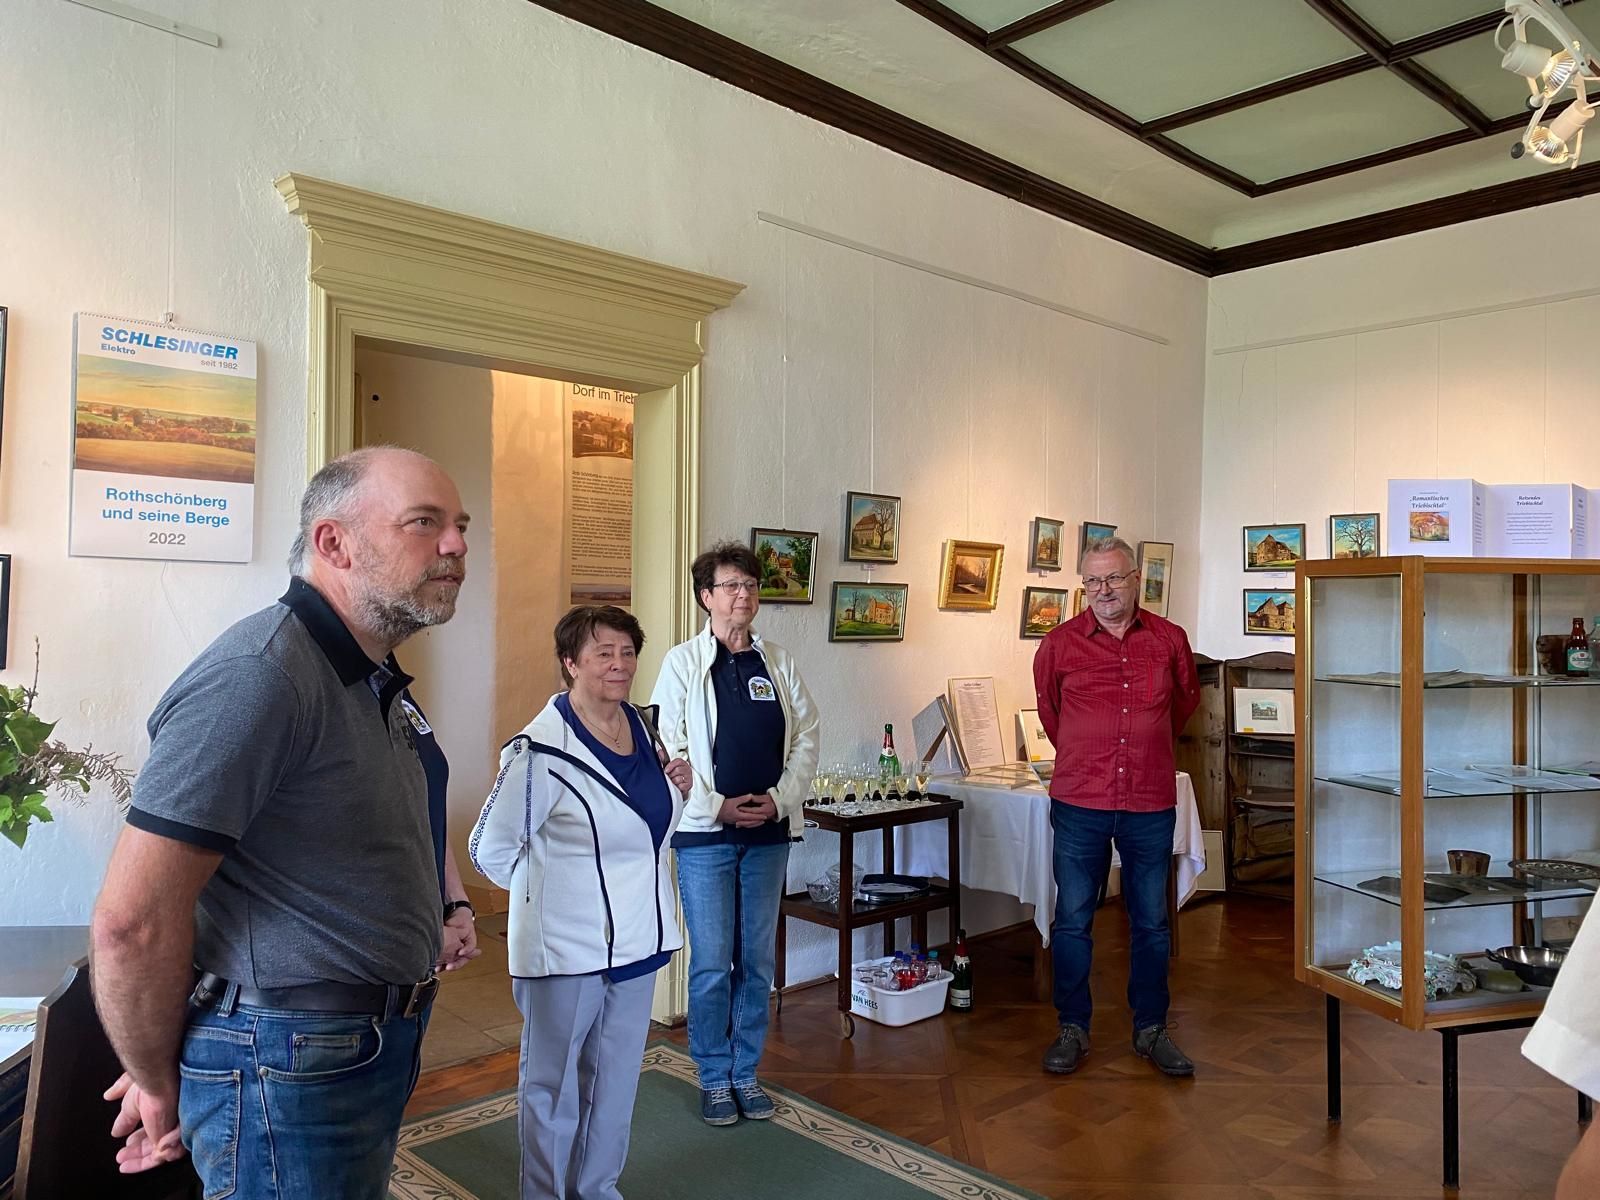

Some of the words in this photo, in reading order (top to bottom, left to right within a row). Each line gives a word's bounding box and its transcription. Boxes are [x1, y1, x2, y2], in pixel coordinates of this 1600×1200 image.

[101, 326, 239, 360] SCHLESINGER
[101, 343, 136, 355] Elektro
[200, 359, 216, 368] seit
[573, 383, 596, 398] Dorf
[598, 388, 611, 401] im
[106, 487, 227, 511] Rothschönberg
[102, 508, 134, 520] und
[138, 510, 181, 523] seine
[185, 511, 230, 528] Berge
[149, 532, 187, 545] 2022
[865, 999, 878, 1010] HEES
